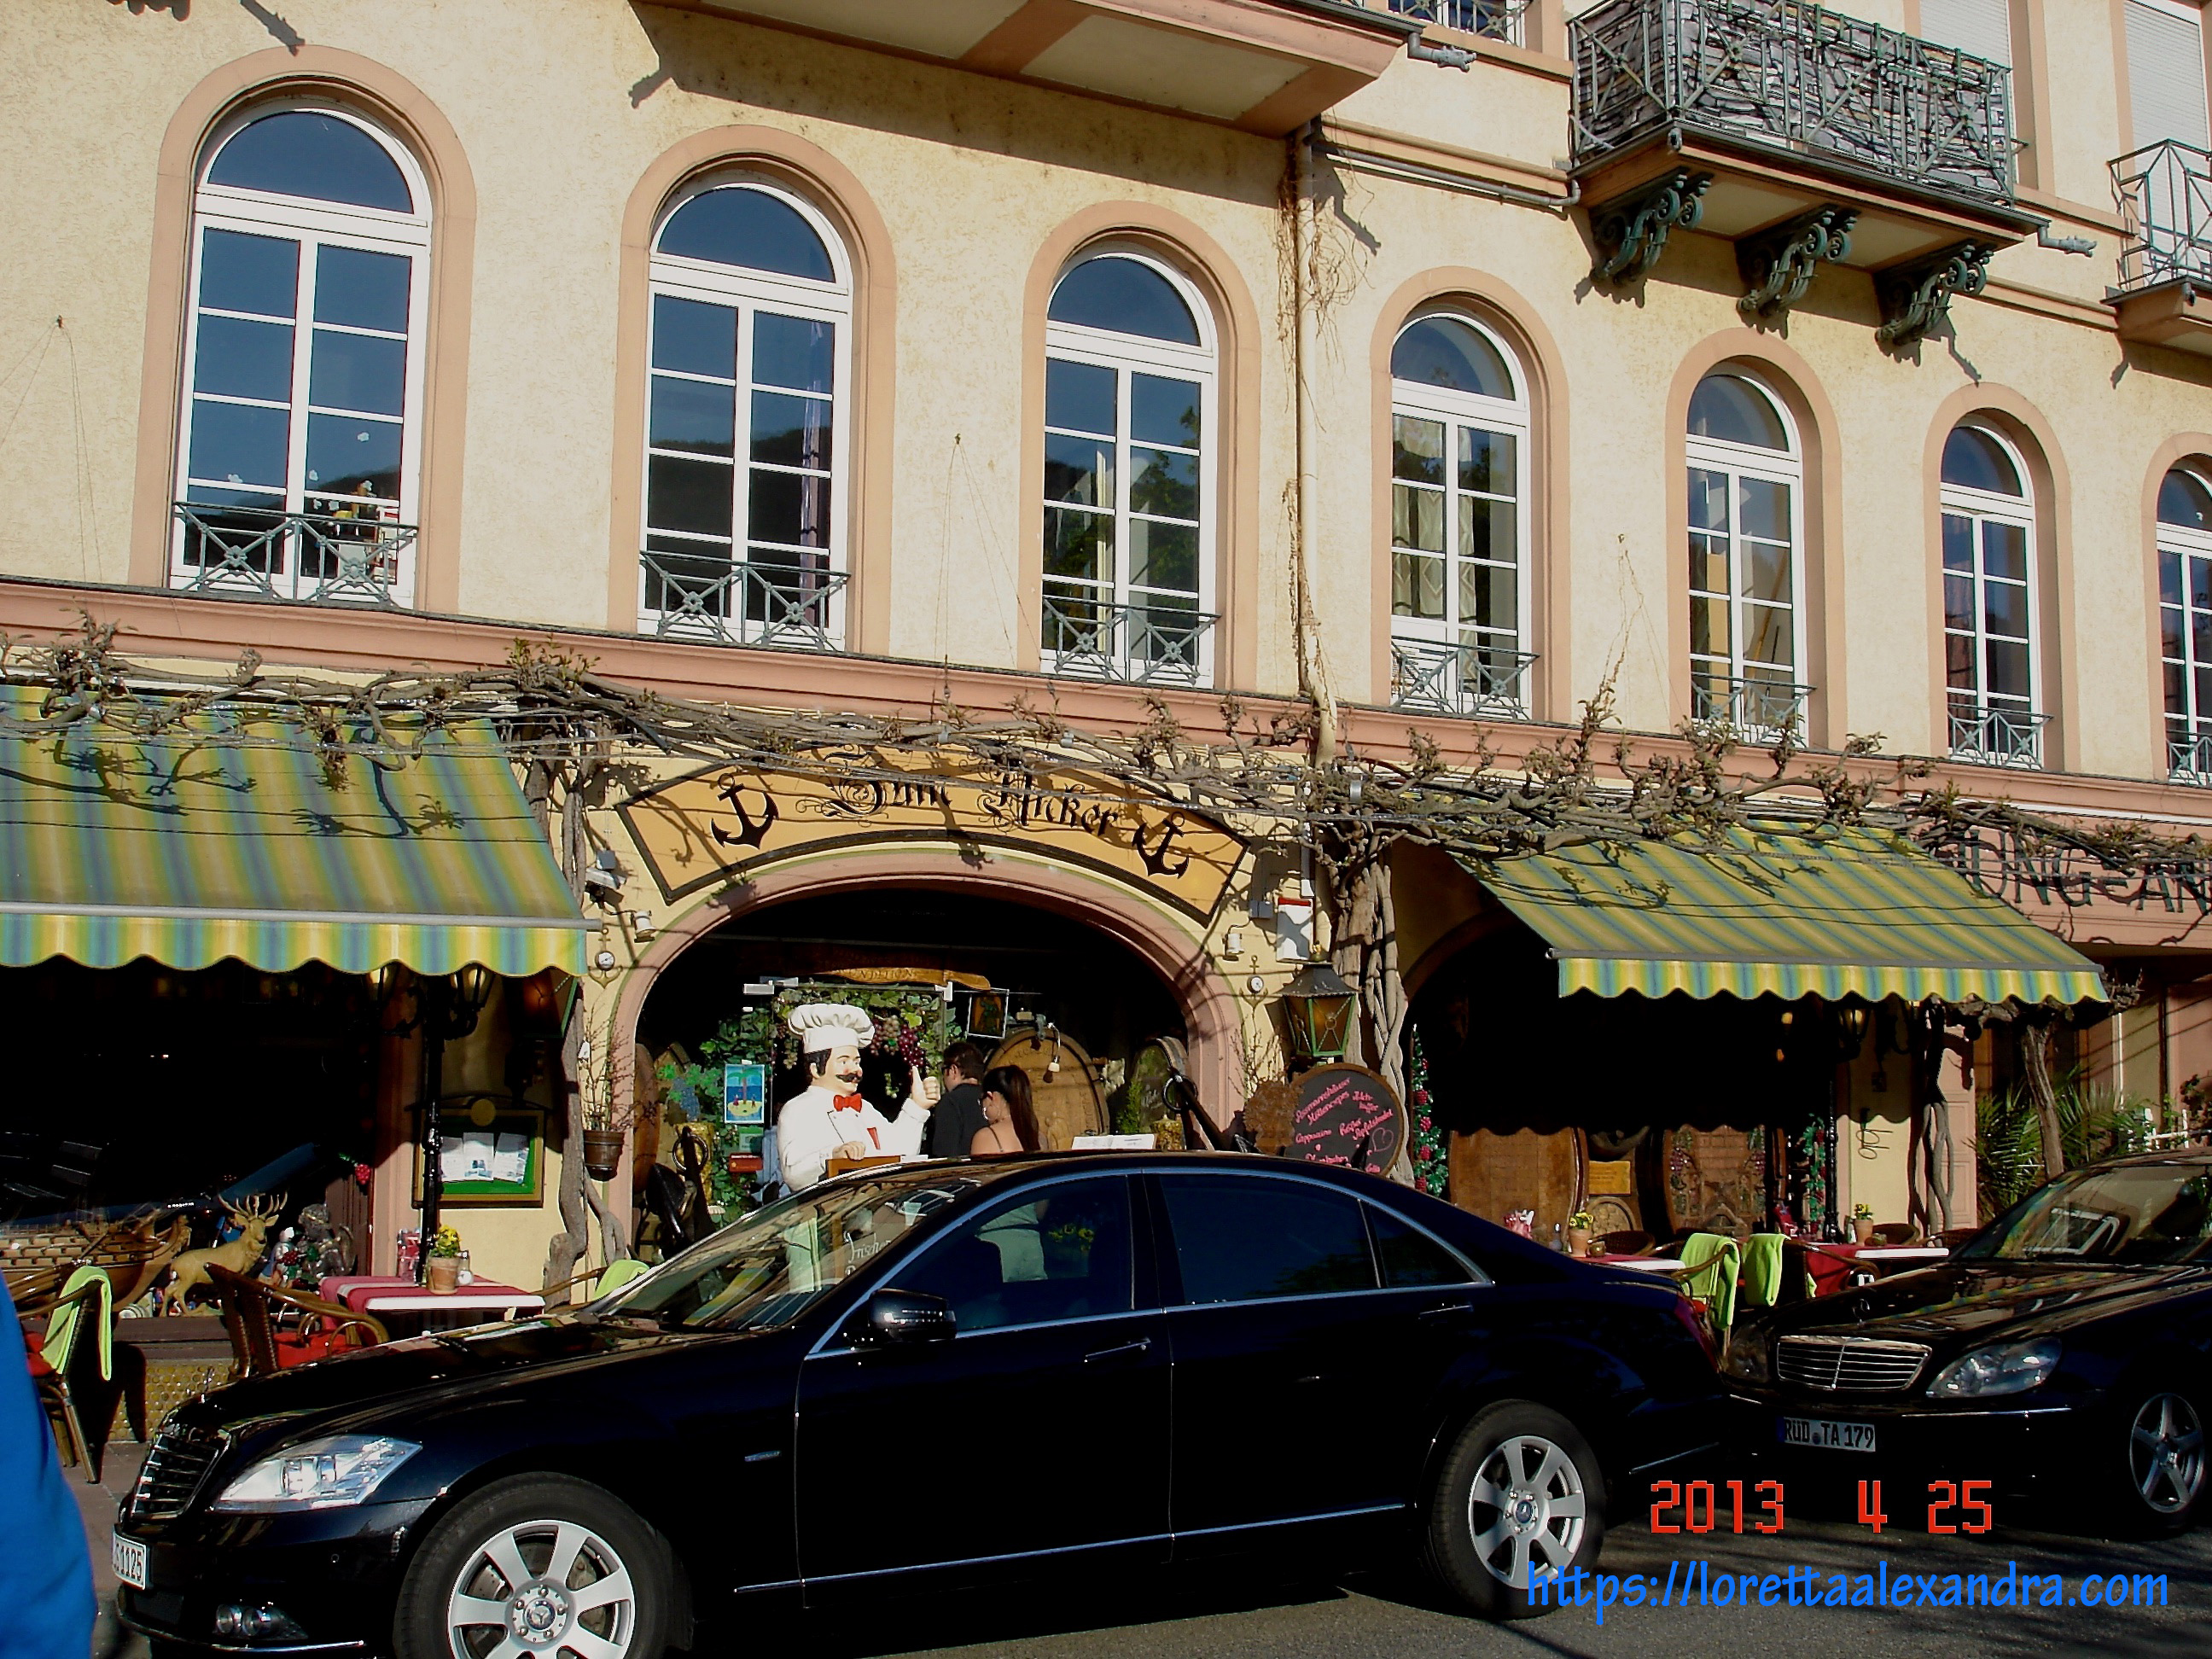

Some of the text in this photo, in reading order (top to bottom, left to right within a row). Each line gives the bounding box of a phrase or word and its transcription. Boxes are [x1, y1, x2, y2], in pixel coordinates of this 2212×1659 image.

[1784, 1419, 1874, 1448] RÜD TA 179
